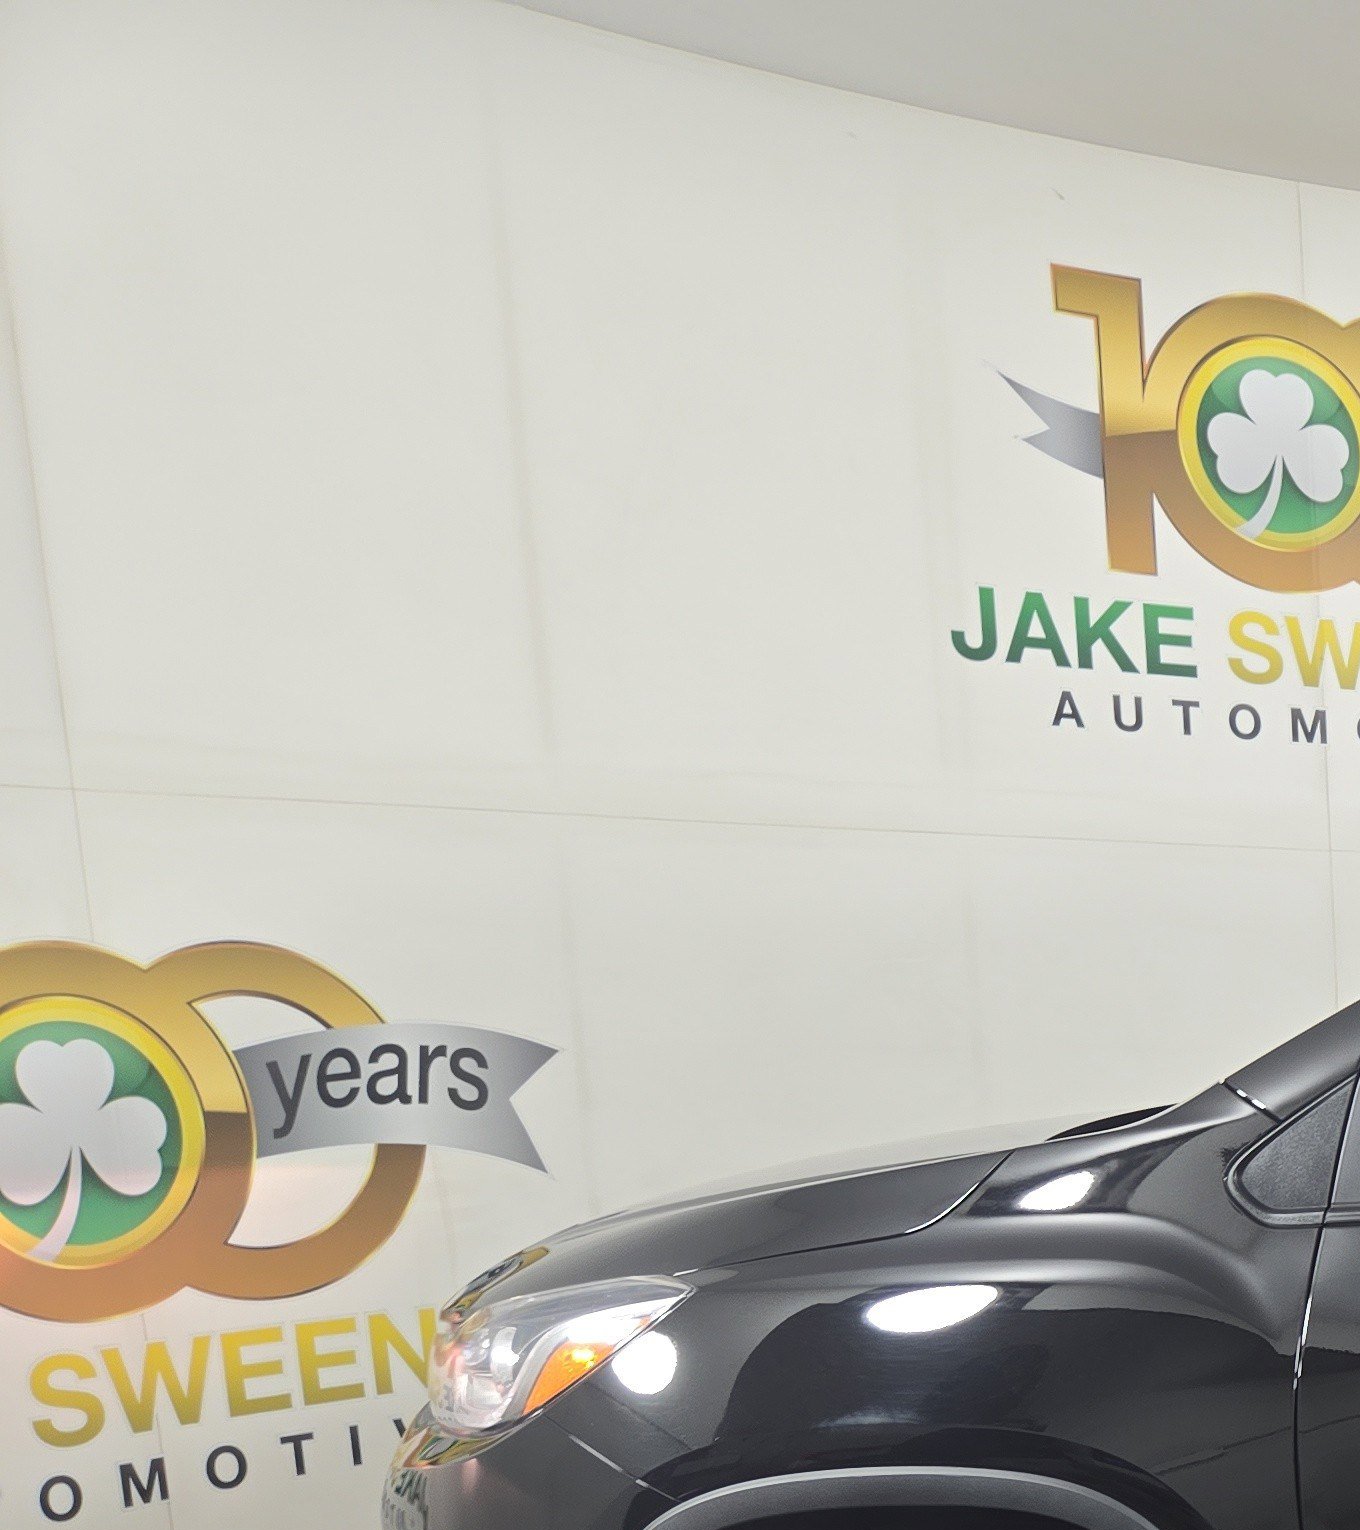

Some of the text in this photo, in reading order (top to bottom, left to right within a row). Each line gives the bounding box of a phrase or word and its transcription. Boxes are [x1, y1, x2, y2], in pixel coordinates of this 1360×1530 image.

[951, 586, 1198, 678] JAKE
[265, 1043, 489, 1139] years
[0, 1419, 408, 1522] OMOTI
